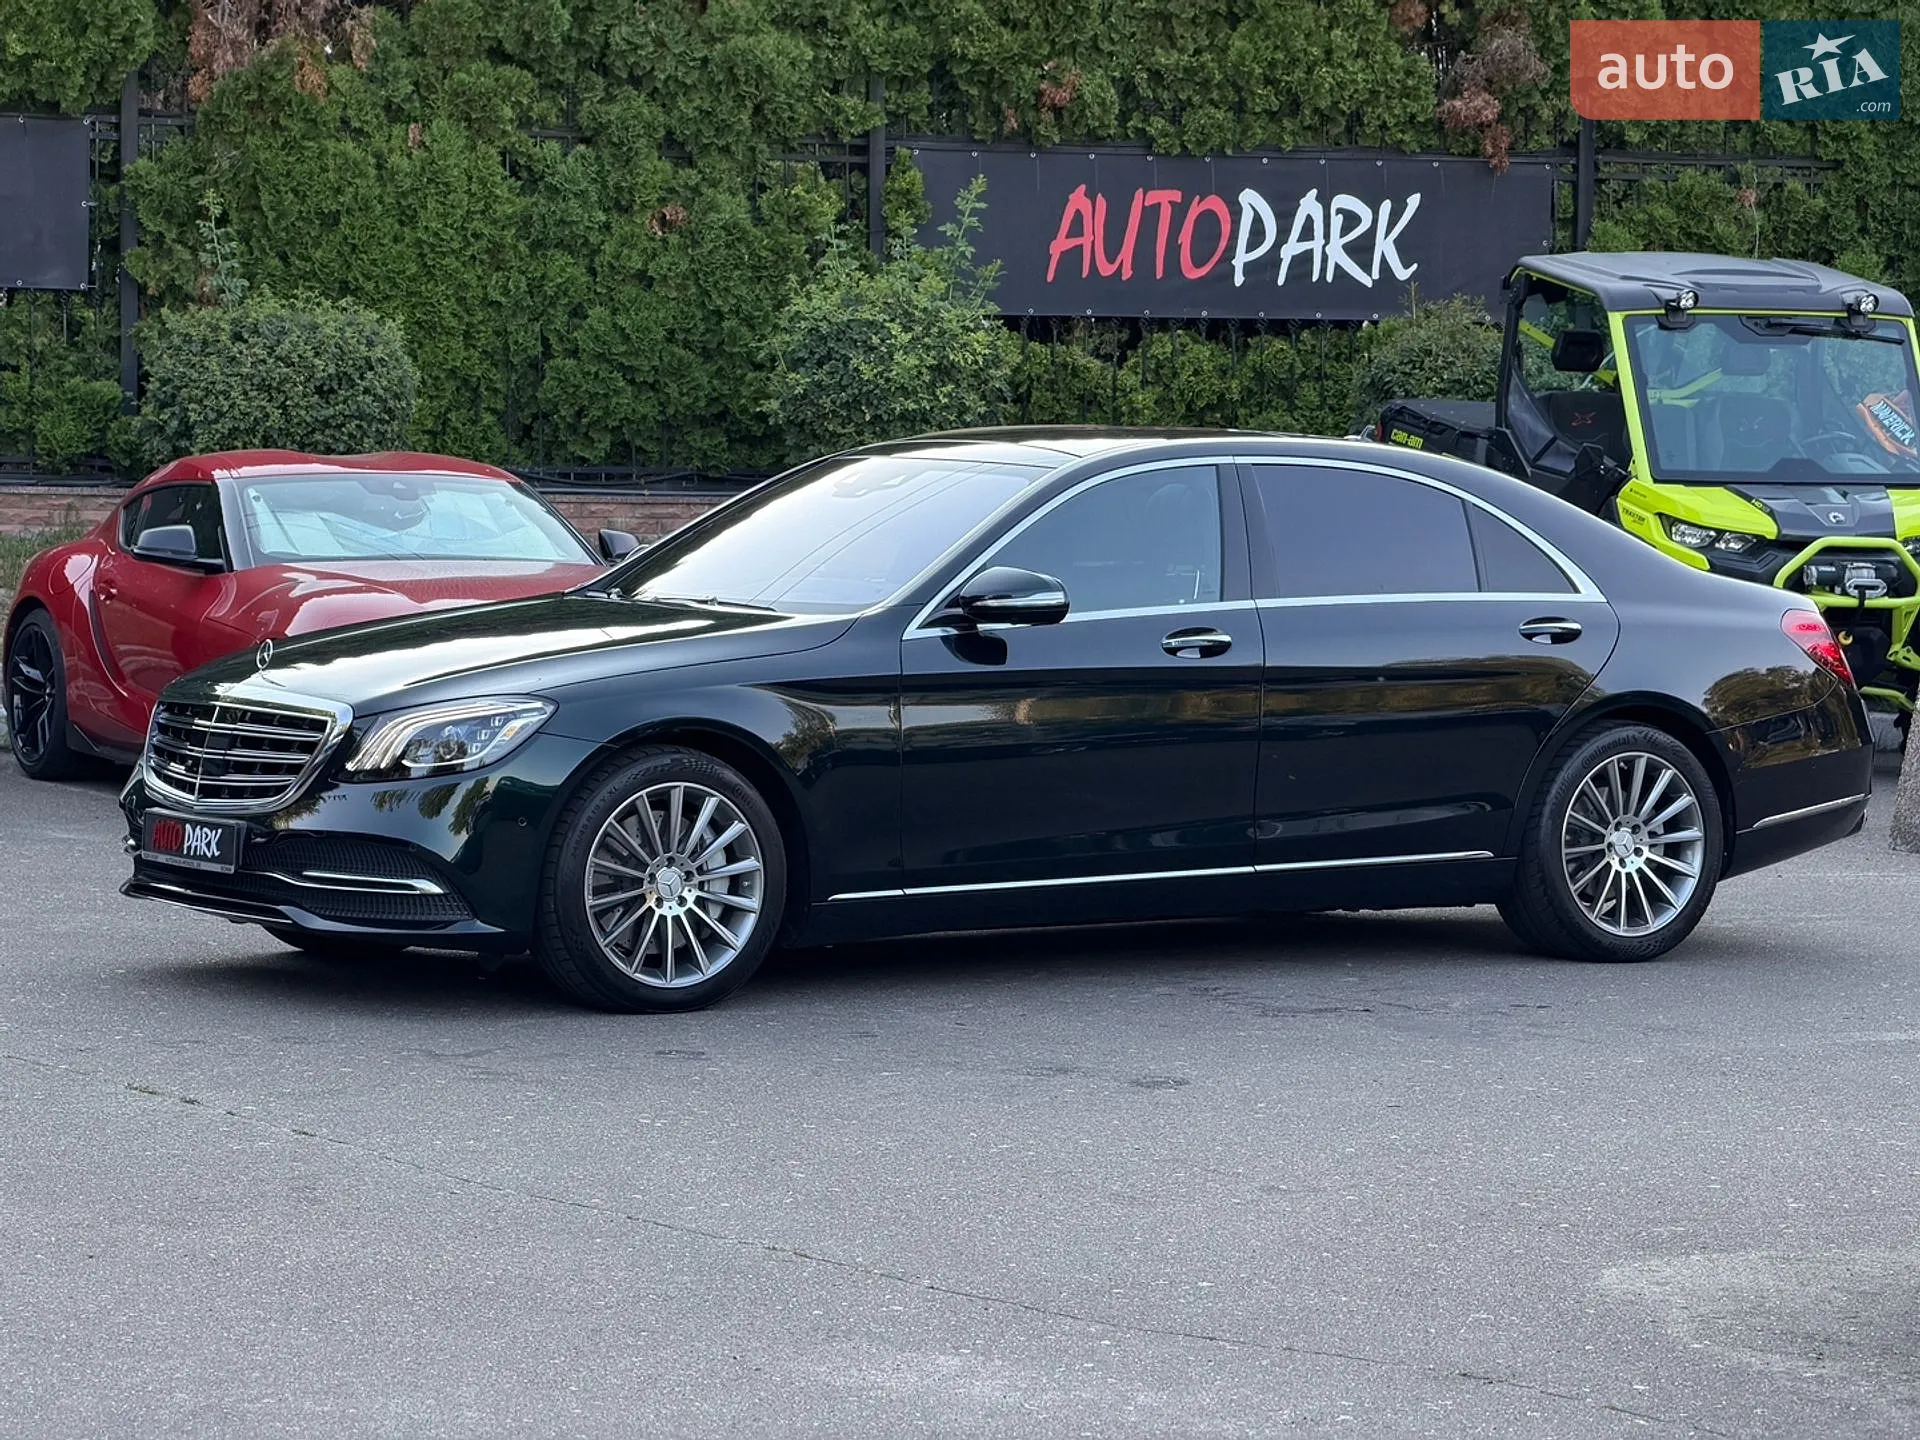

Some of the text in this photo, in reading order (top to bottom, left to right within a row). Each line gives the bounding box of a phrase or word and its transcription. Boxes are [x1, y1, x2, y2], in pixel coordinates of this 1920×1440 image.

[1046, 183, 1421, 288] AUTOPARK
[1391, 428, 1424, 449] can-am
[1869, 400, 1915, 446] MAVERICK
